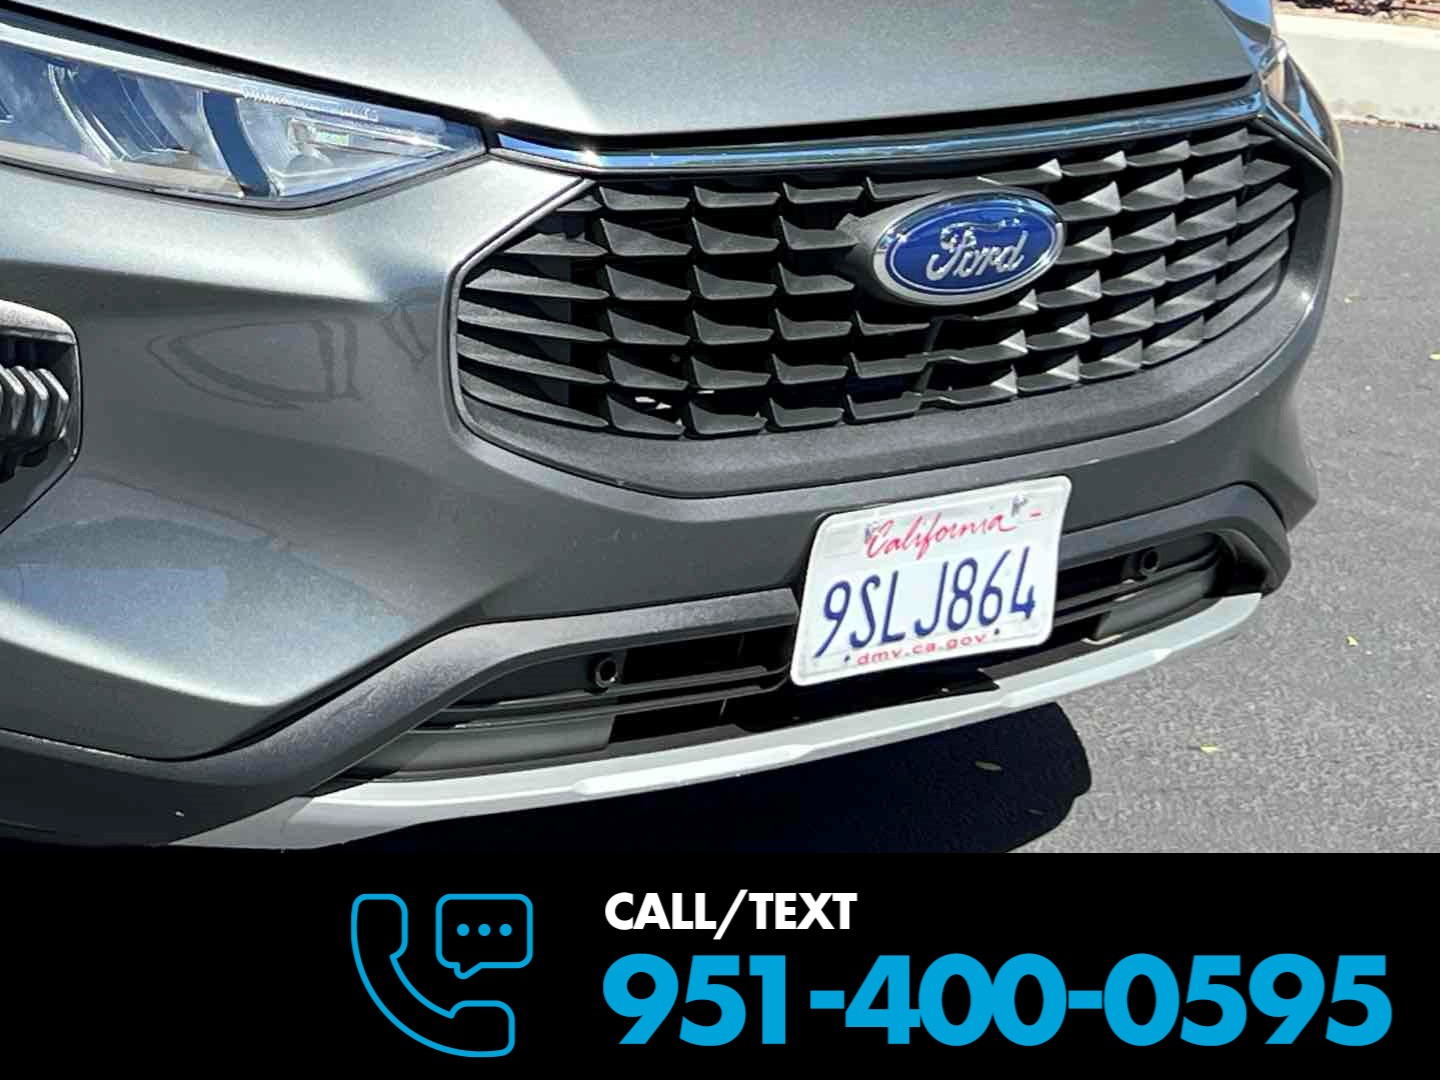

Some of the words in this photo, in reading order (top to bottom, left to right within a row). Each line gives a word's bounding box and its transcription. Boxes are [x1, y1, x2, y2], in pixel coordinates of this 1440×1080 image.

[926, 218, 1028, 282] Ford
[866, 513, 1016, 560] California
[814, 546, 1036, 658] 9SLJ864
[856, 632, 987, 666] dmv.ca.gov
